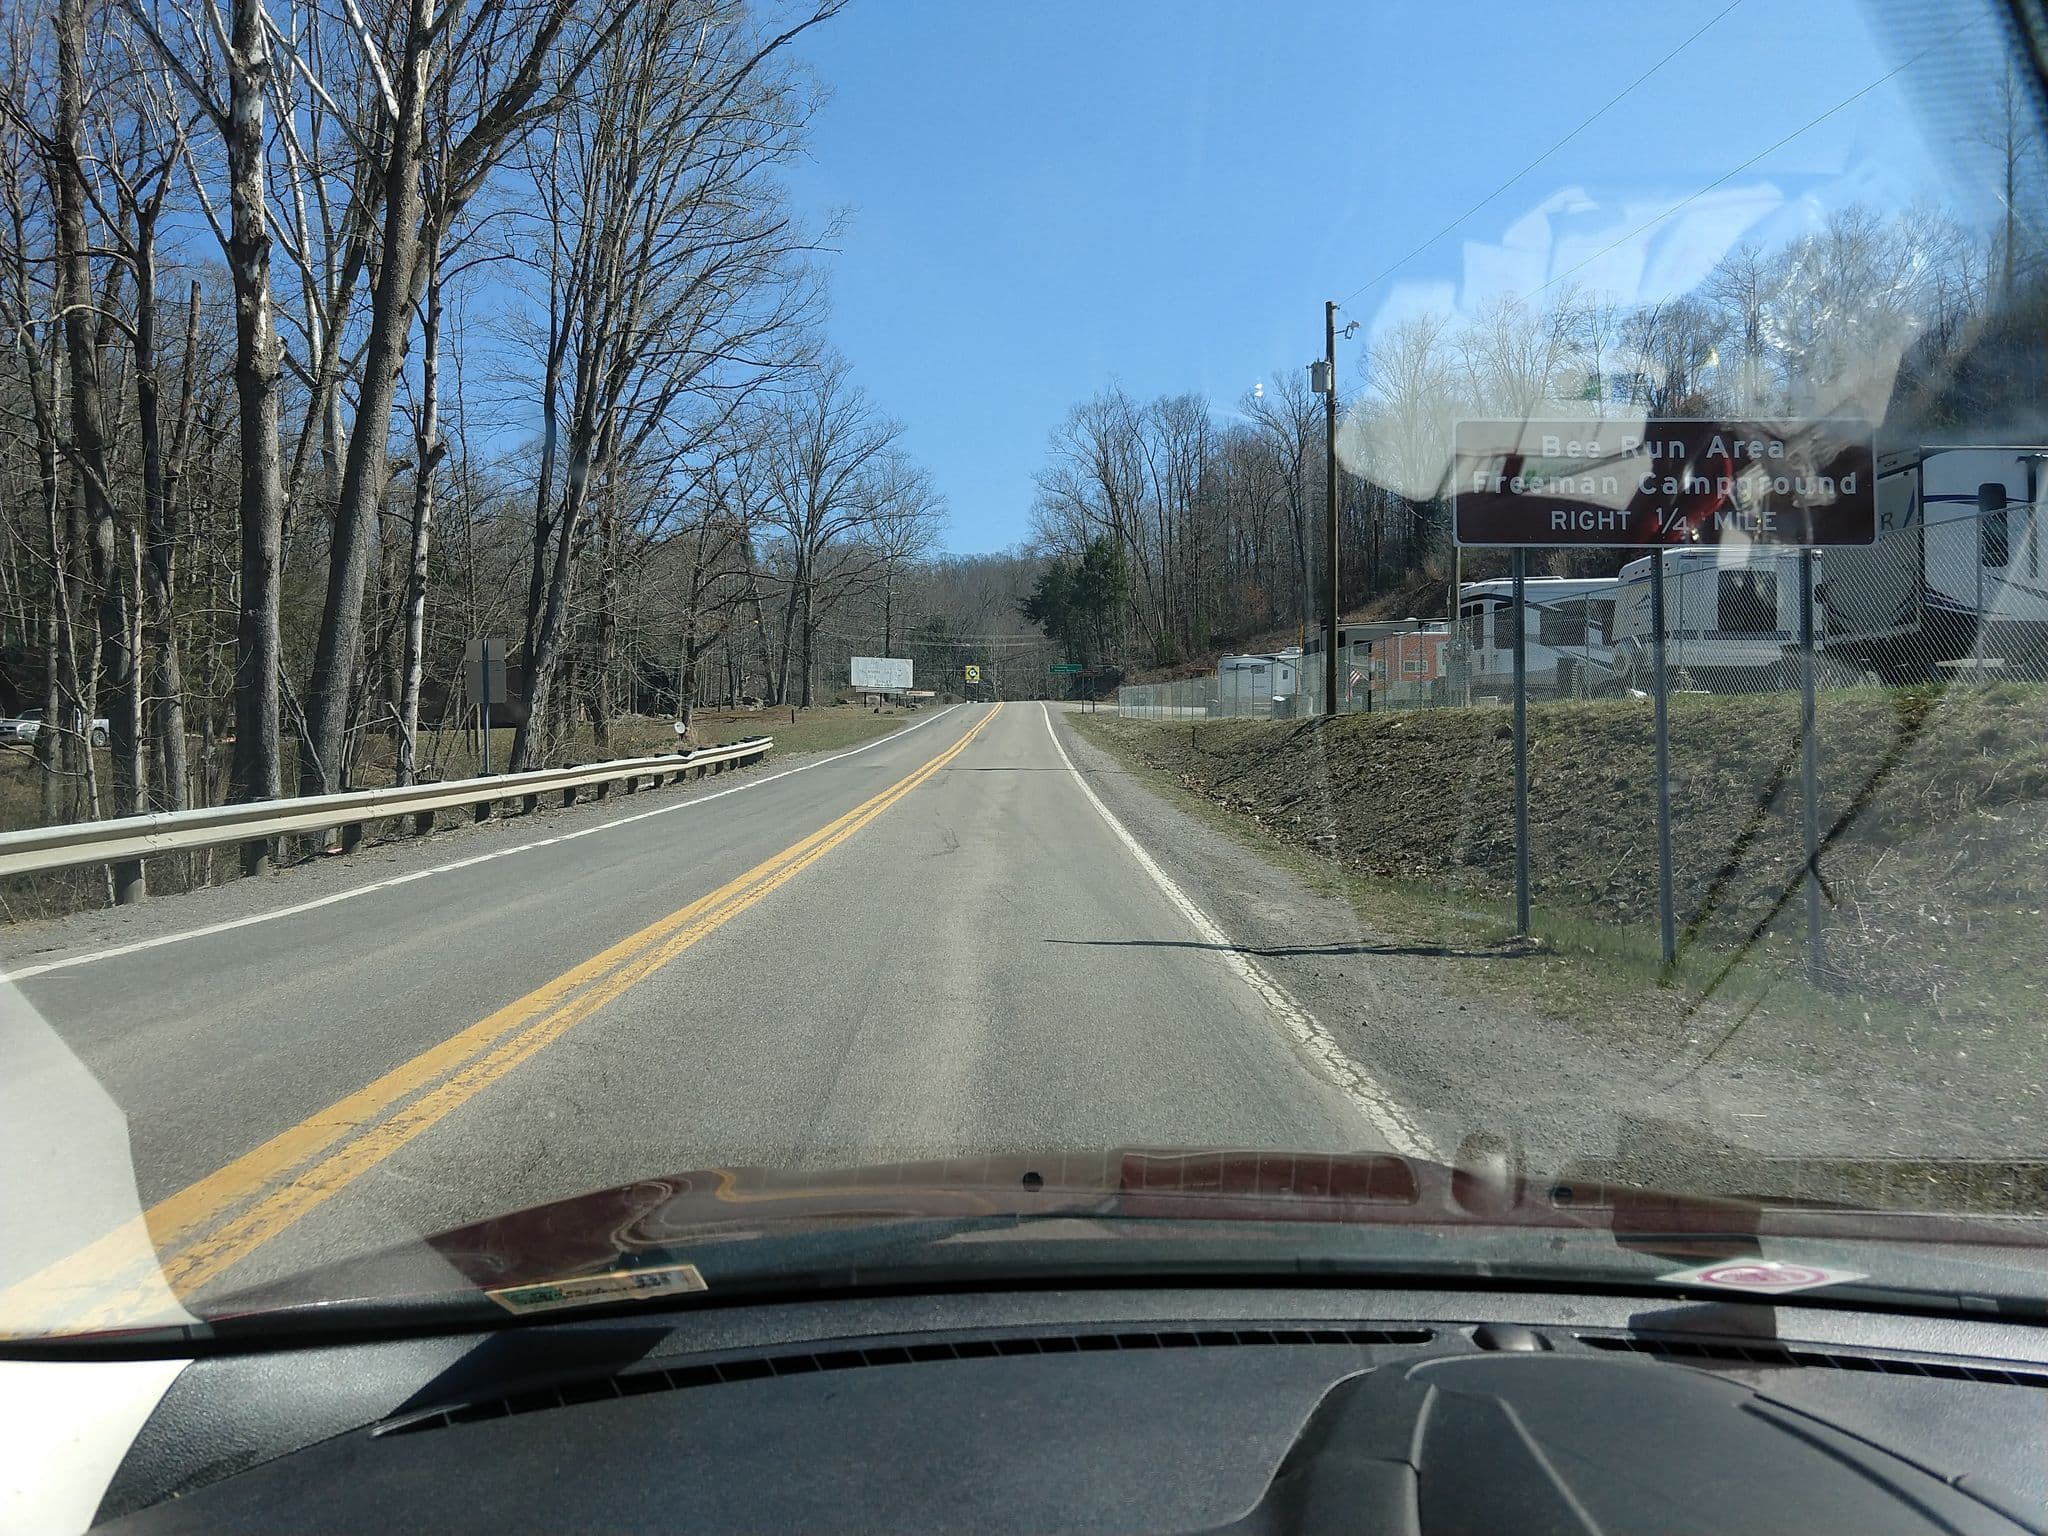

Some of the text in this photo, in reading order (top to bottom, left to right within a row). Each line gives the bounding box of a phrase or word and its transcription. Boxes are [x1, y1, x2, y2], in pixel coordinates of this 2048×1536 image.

[1541, 435, 1785, 459] Bee Run Area
[1473, 470, 1857, 501] Freeman Campground
[1551, 510, 1632, 531] RIGHT
[1714, 511, 1777, 531] MILE
